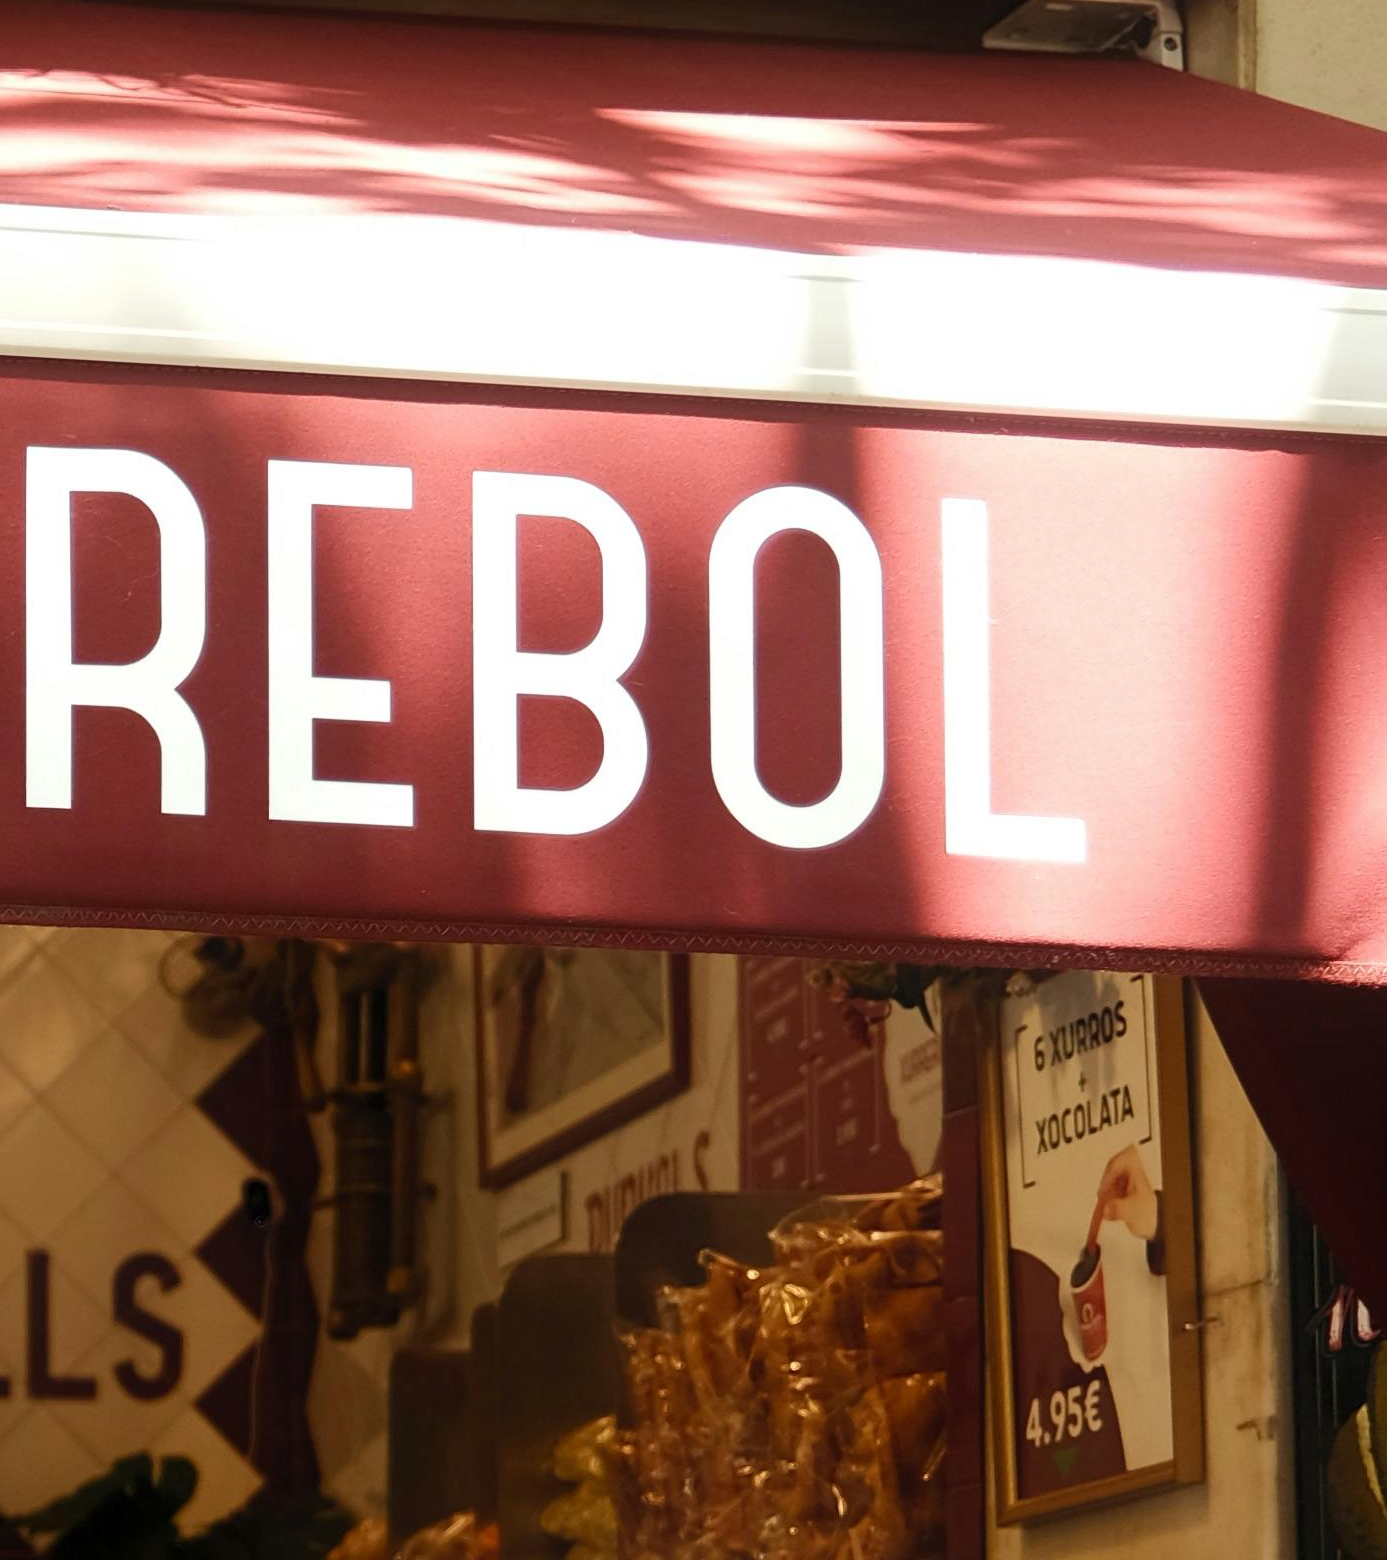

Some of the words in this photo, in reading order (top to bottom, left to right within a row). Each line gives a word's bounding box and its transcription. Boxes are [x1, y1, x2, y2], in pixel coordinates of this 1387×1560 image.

[1034, 1035, 1045, 1072] 6
[1048, 999, 1127, 1067] XURROS
[1035, 1085, 1135, 1156] XOCOLATA
[1026, 1379, 1103, 1448] 4.95€
